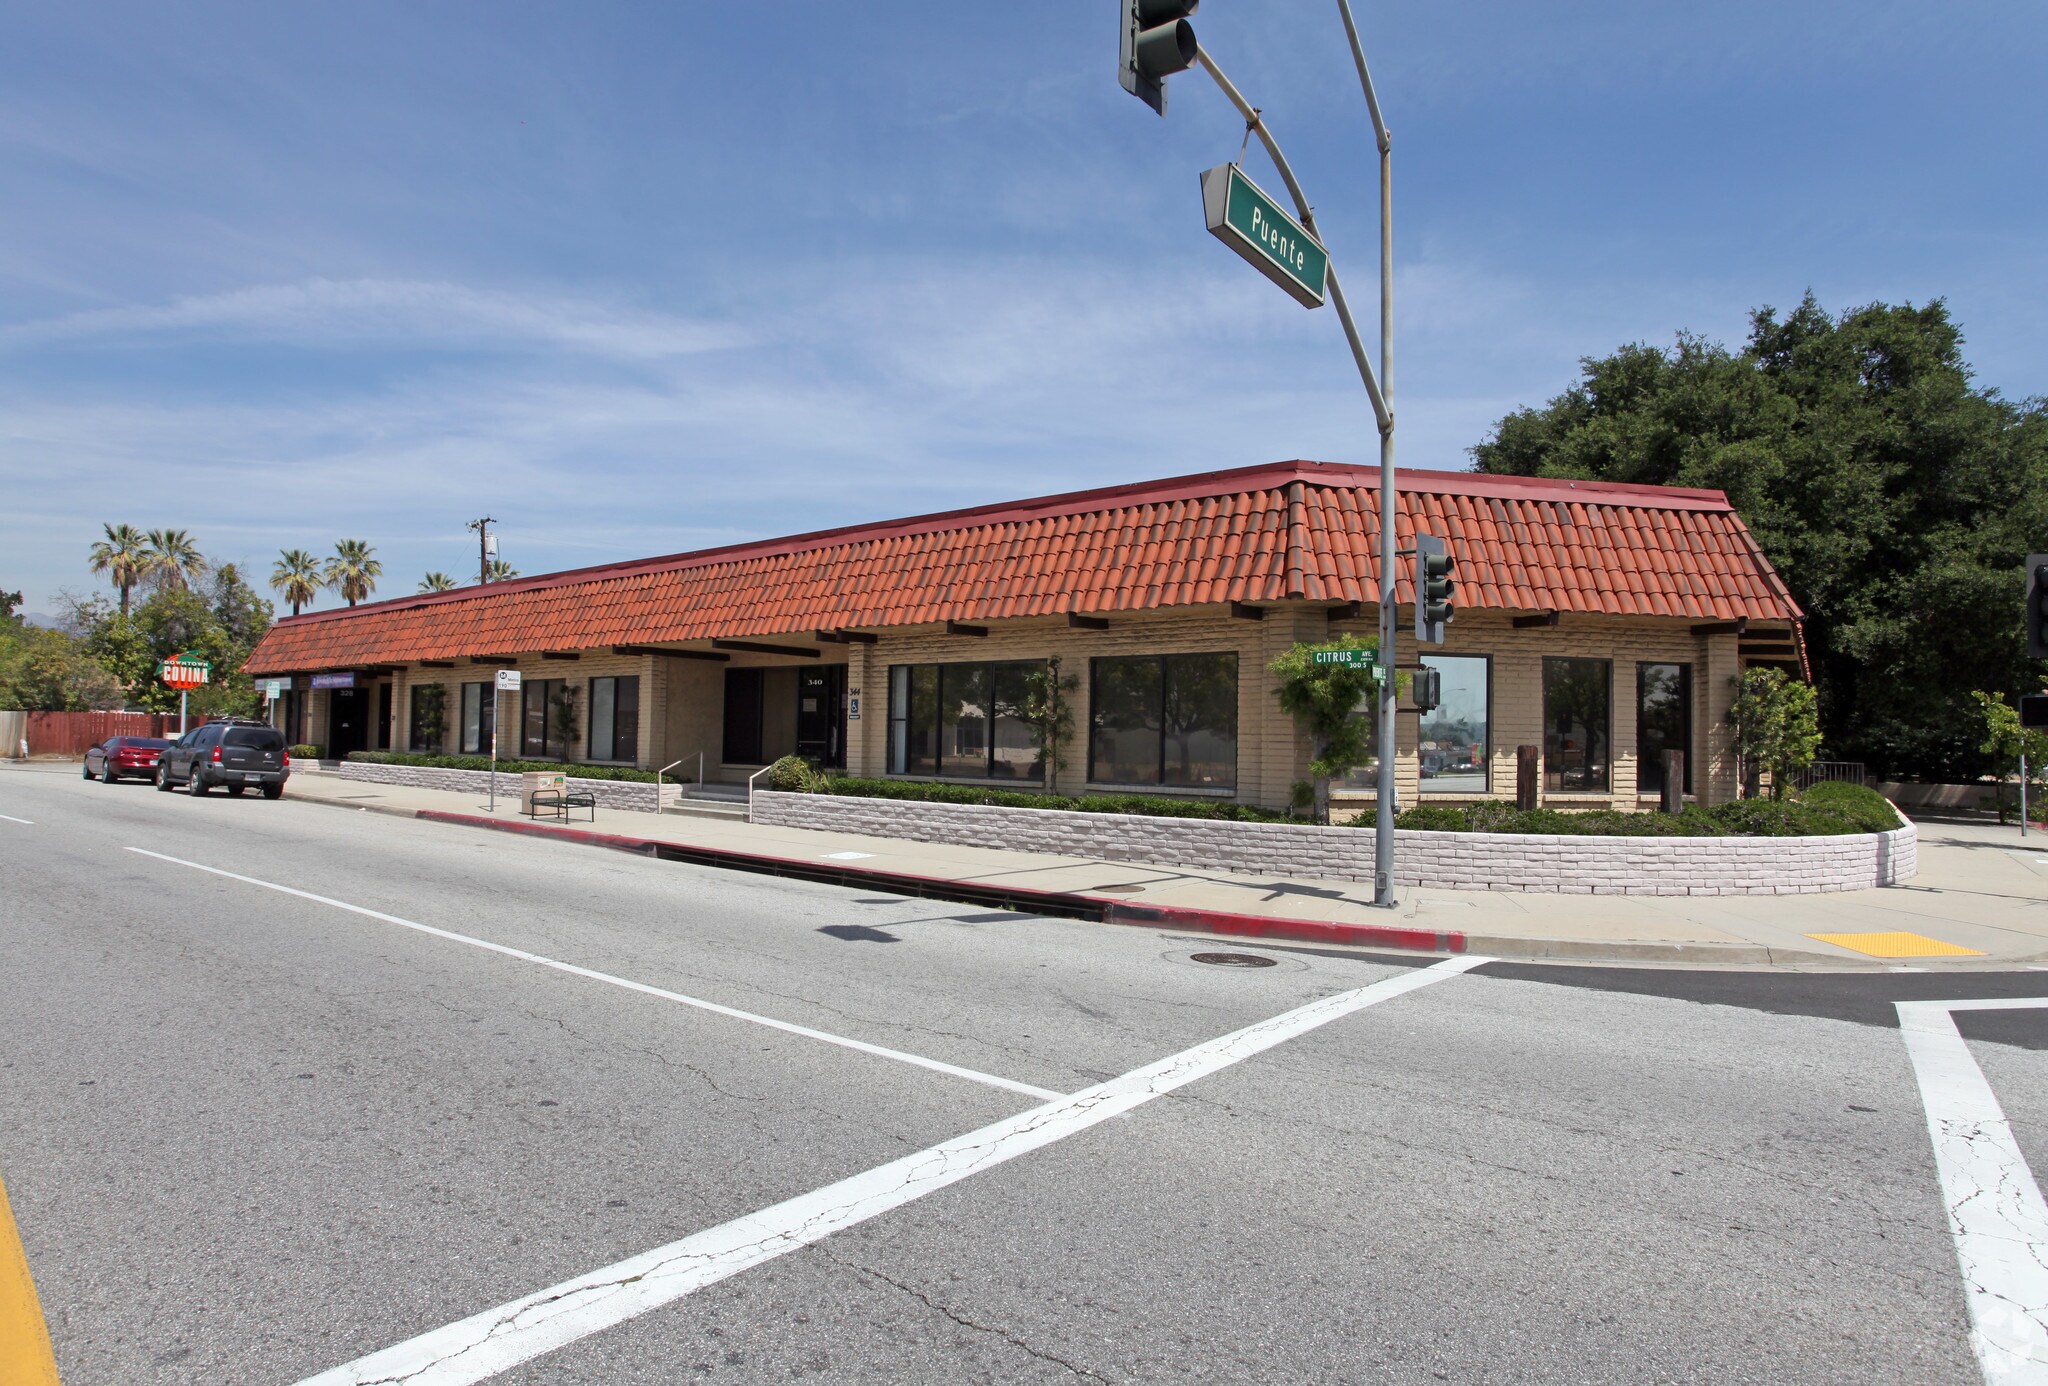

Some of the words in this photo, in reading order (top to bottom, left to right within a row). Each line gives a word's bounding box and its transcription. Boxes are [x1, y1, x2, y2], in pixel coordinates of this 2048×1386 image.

[1252, 206, 1304, 271] Puente
[1316, 651, 1352, 662] CITRUS
[164, 666, 209, 683] COVINA
